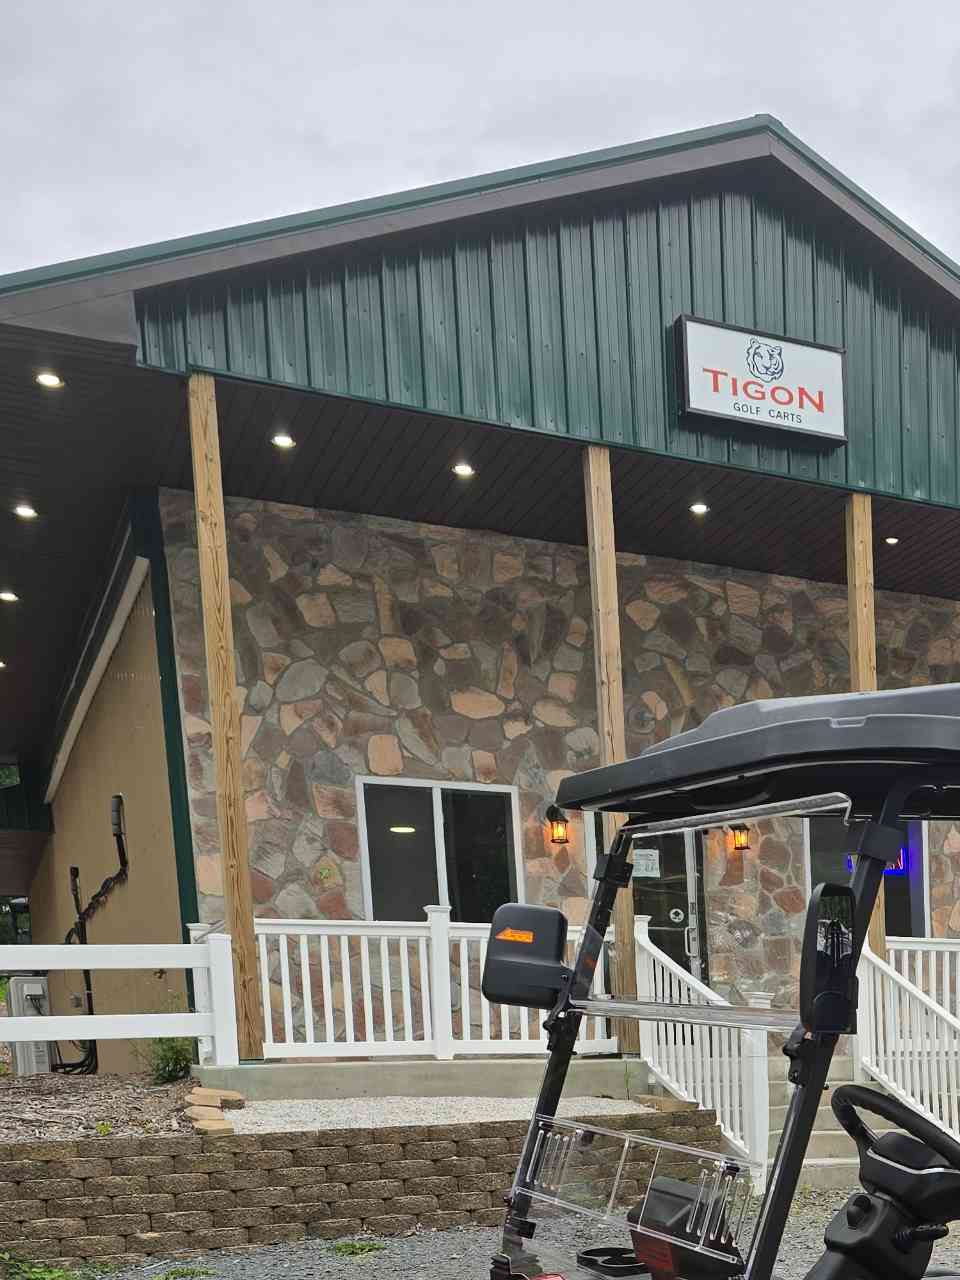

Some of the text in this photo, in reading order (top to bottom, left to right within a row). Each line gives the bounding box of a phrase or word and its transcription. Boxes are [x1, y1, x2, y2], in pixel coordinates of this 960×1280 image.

[703, 367, 825, 413] TIGON
[733, 402, 802, 424] GOLF CARTS
